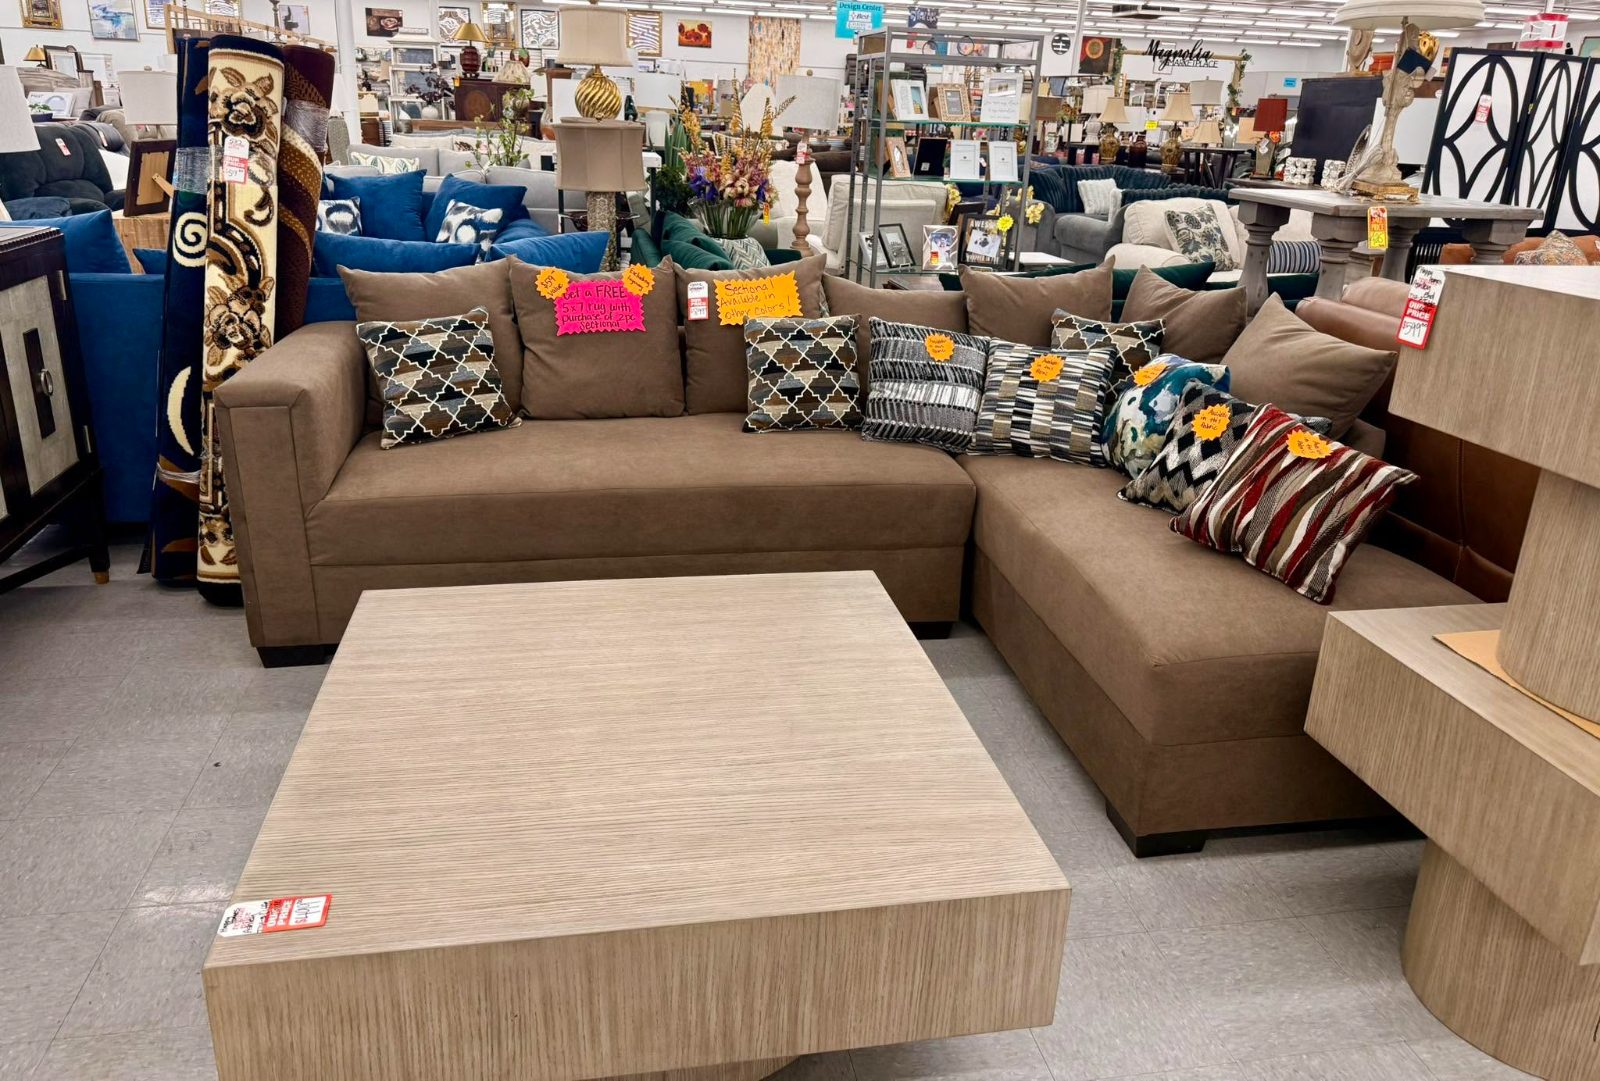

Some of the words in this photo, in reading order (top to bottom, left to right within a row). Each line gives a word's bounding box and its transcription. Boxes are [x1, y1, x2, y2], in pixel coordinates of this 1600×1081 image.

[839, 2, 861, 10] Design
[1142, 39, 1214, 71] Magnolia
[1167, 58, 1219, 69] MARKETPLACE
[563, 287, 580, 300] Get
[585, 289, 592, 297] a
[596, 286, 628, 299] FREE
[724, 279, 774, 297] Sectional
[720, 294, 760, 308] Available
[588, 302, 606, 315] rug
[609, 302, 632, 313] with
[1406, 308, 1431, 320] PRICE
[604, 311, 613, 320] of
[276, 900, 293, 925] PRICE
